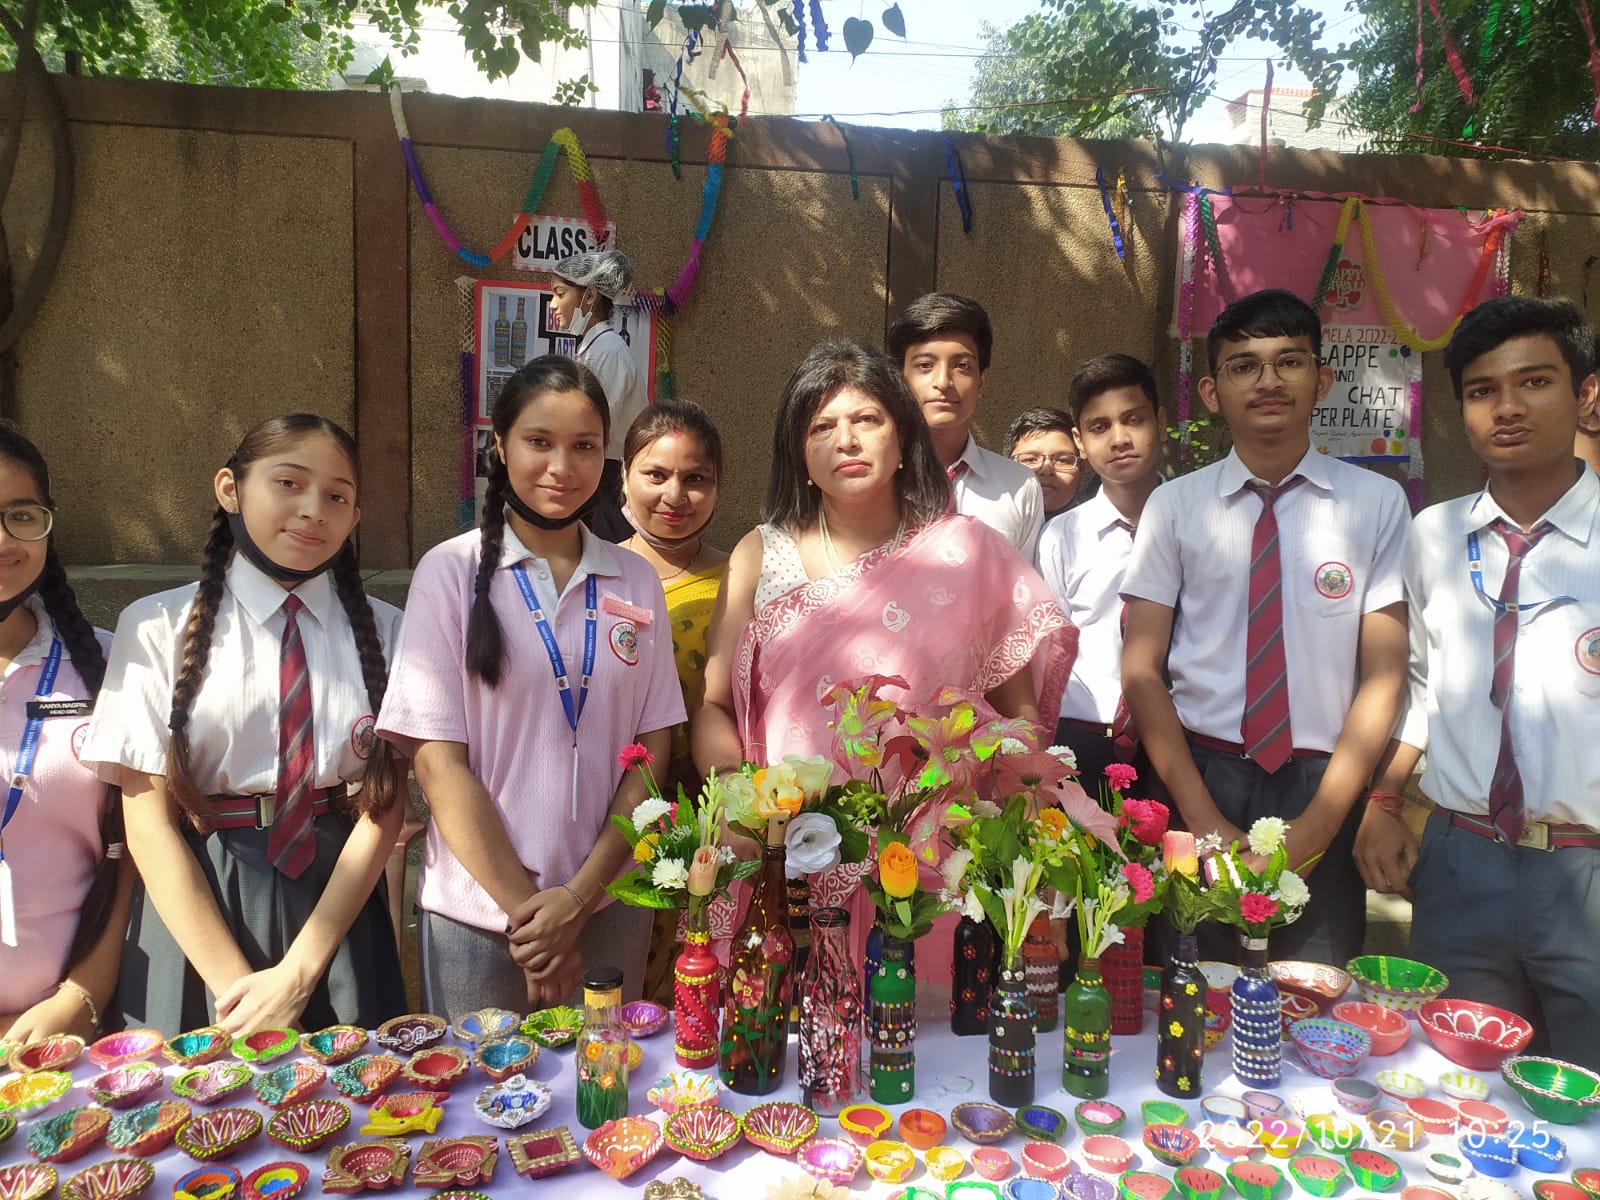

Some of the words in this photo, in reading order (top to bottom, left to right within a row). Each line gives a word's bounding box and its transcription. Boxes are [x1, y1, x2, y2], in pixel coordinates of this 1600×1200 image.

[518, 225, 610, 260] CLASS-
[1321, 328, 1352, 343] MELA
[1356, 328, 1400, 344] 2022-2
[1348, 386, 1403, 406] CHAT
[1342, 407, 1395, 428] PLATE
